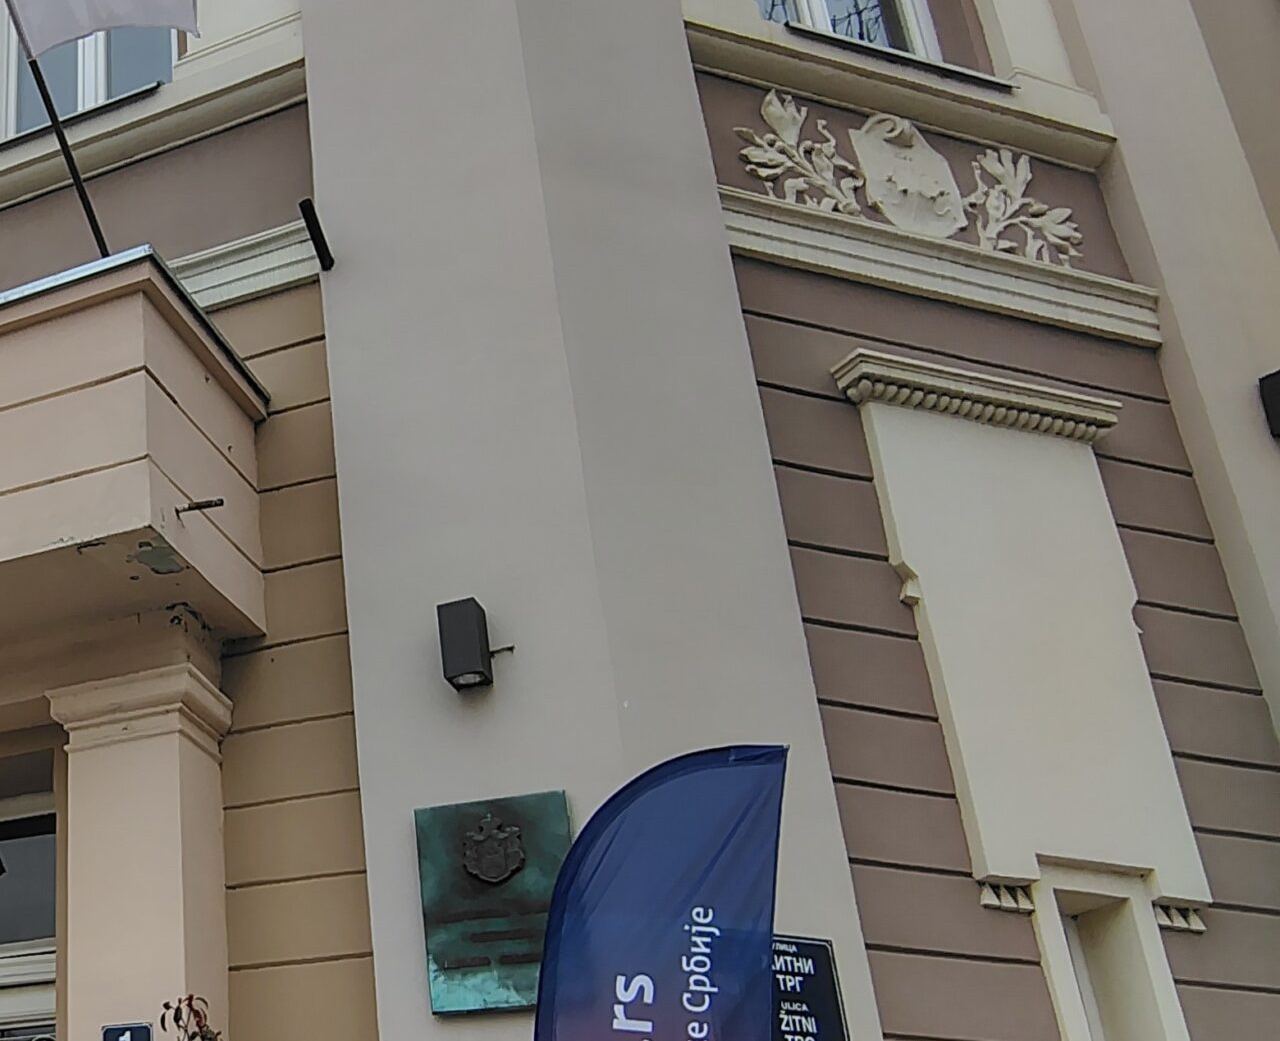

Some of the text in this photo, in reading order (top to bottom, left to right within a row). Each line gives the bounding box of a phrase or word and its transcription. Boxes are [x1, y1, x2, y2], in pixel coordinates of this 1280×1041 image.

[681, 906, 721, 1041] е Србије
[772, 954, 815, 975] ИТНИ
[776, 973, 803, 992] ТРГ
[612, 974, 654, 1041] rs
[781, 1001, 809, 1012] ULICA
[779, 1010, 818, 1034] ŽITNI
